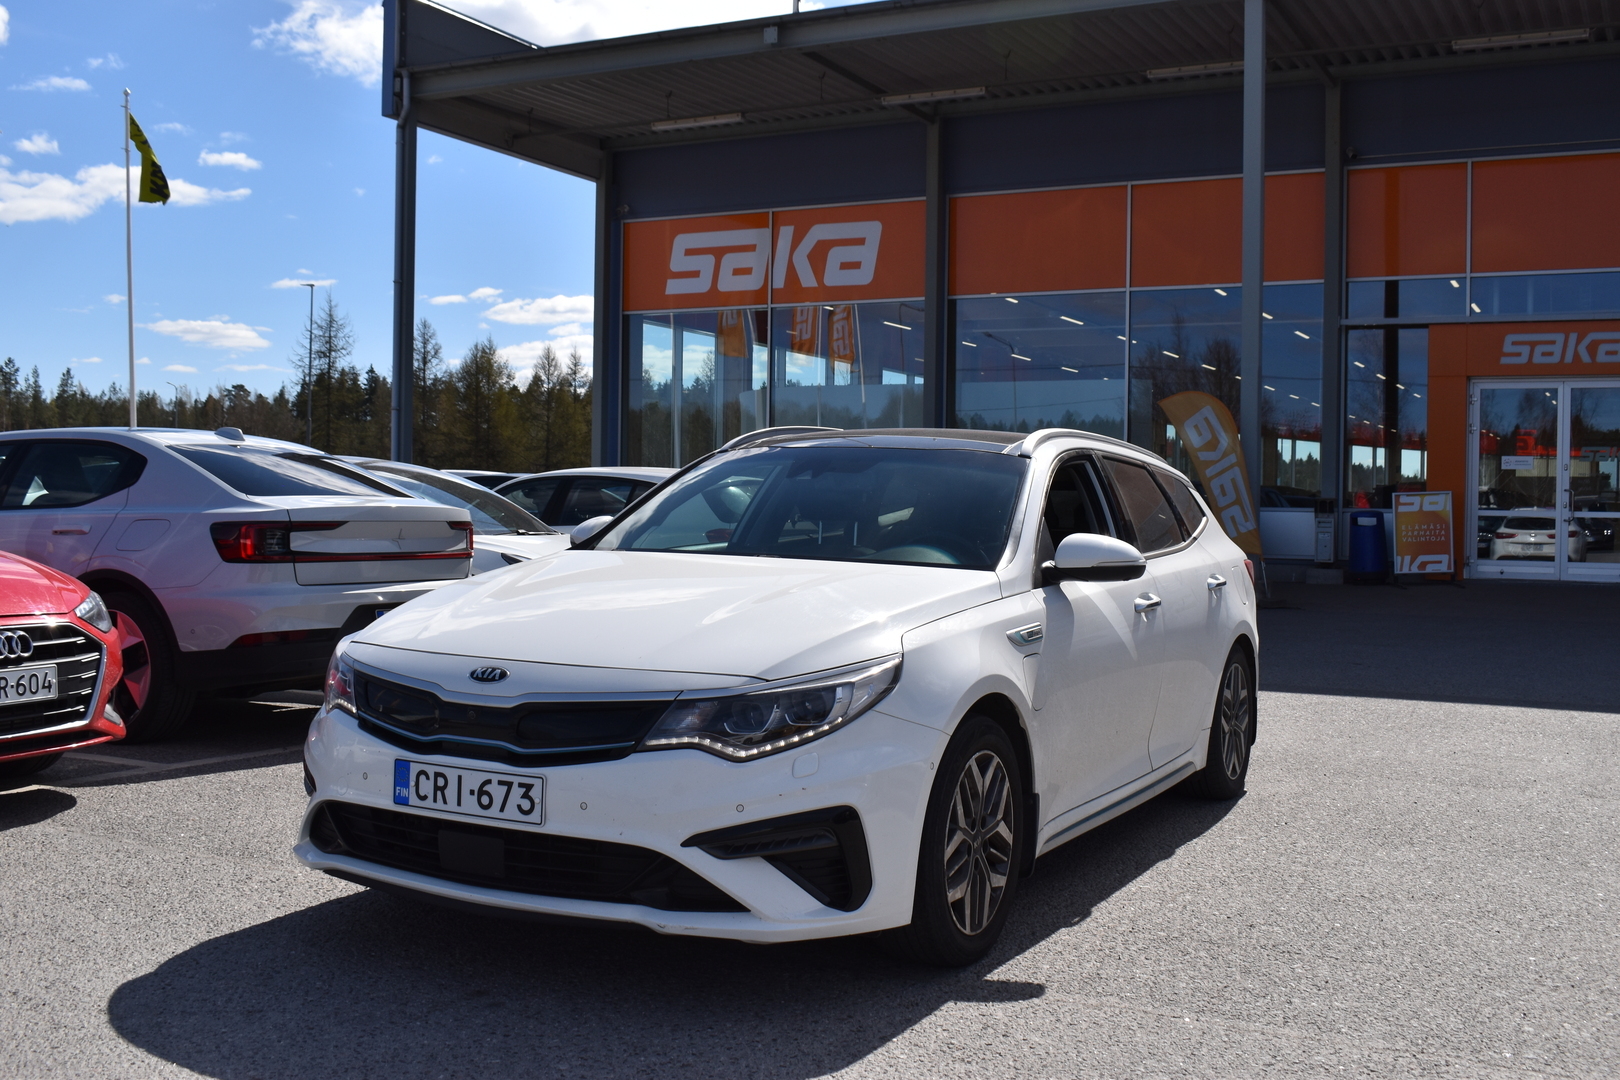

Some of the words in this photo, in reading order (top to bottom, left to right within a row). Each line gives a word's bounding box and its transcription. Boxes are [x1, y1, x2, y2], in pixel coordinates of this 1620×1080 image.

[473, 667, 501, 680] KIA
[396, 786, 409, 798] FIN
[415, 769, 536, 816] CRI-673
